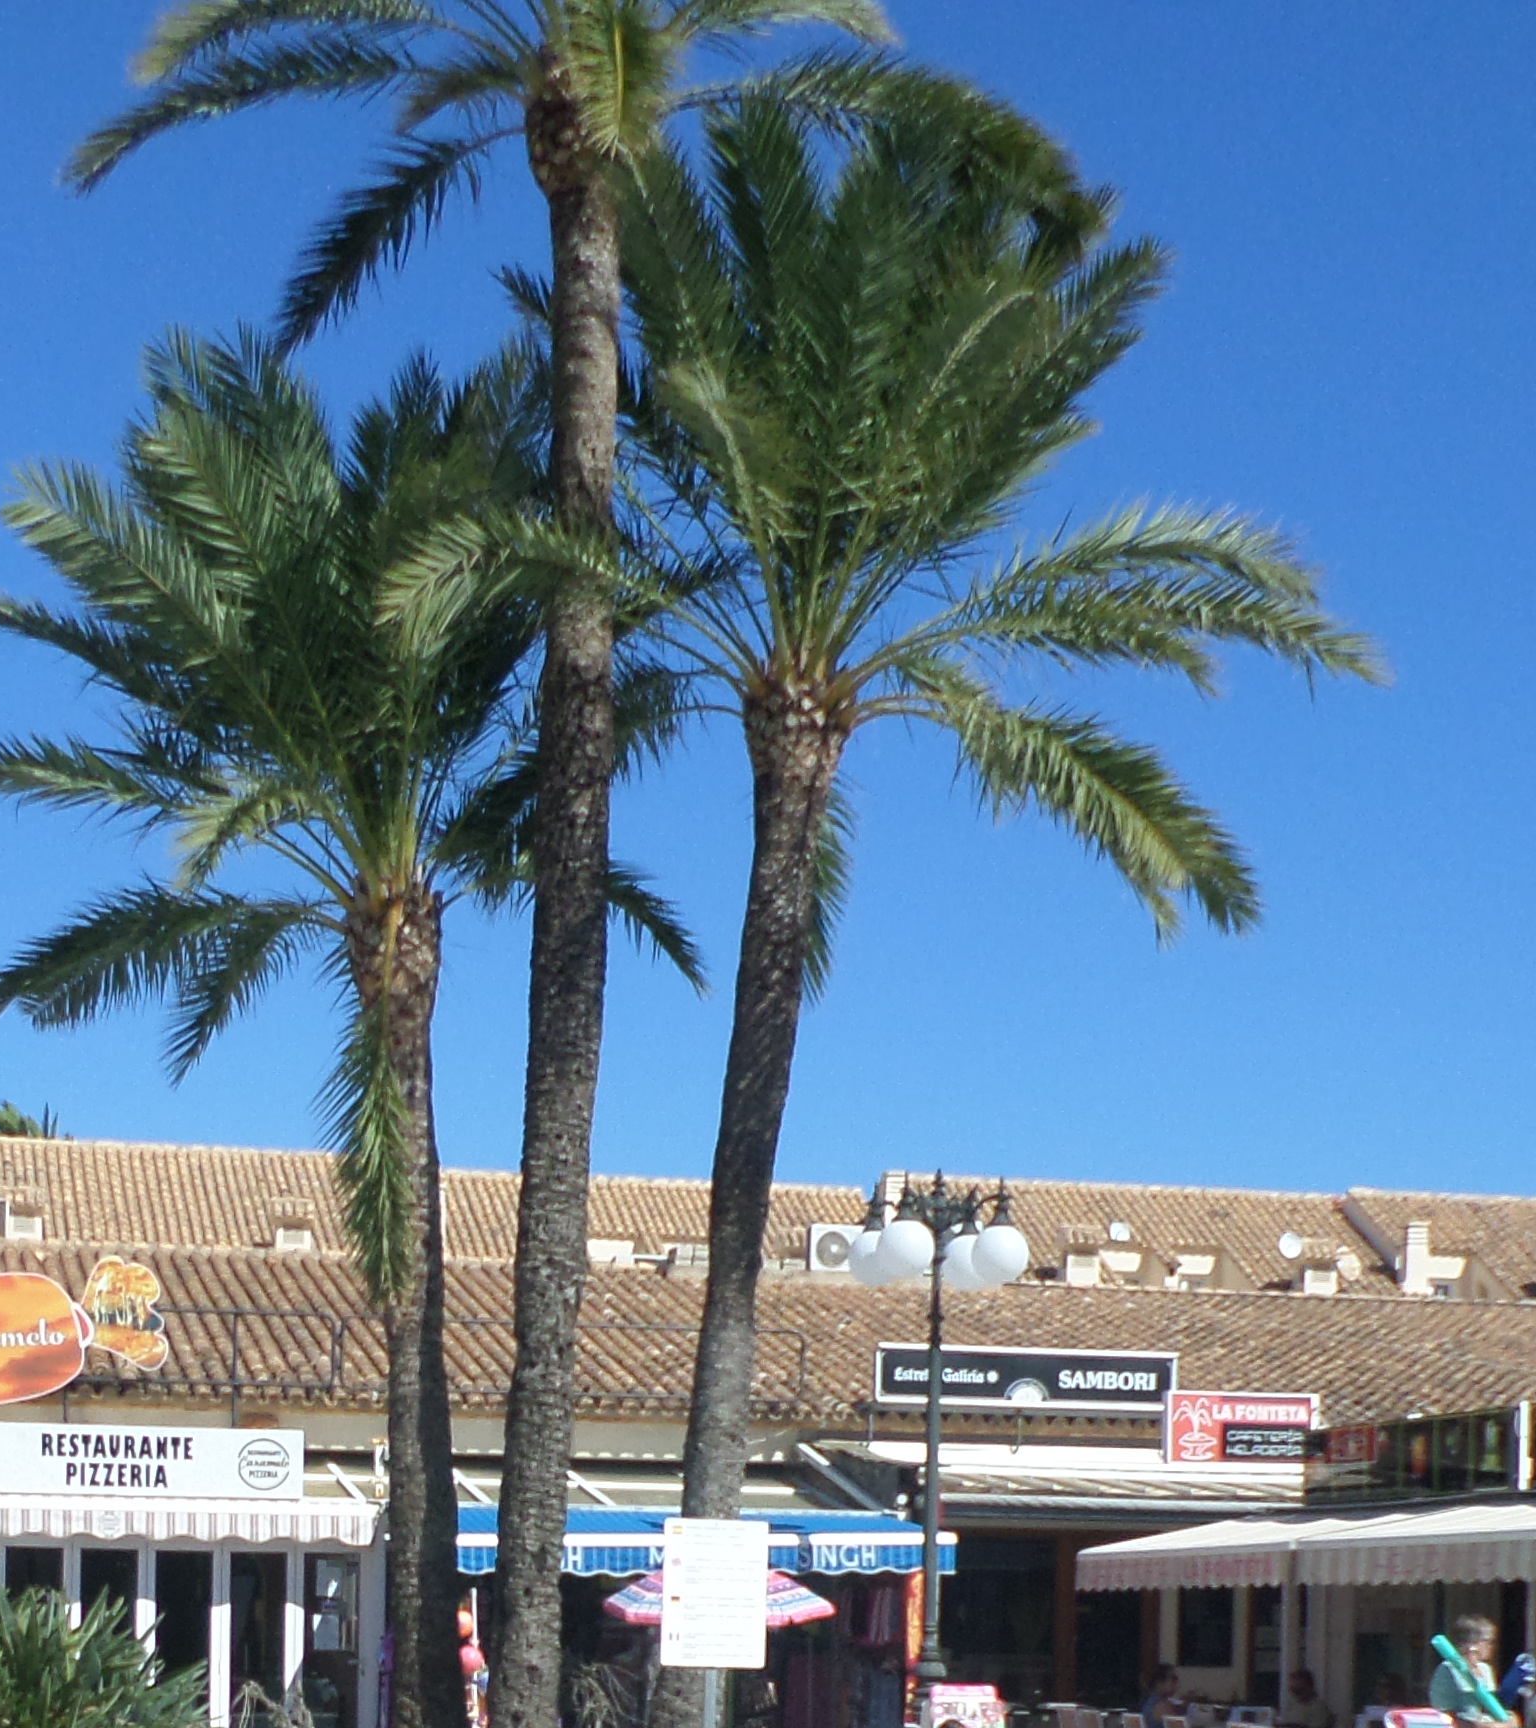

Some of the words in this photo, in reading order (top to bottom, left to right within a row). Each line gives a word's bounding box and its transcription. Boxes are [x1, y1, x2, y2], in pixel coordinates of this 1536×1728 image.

[1058, 1370, 1157, 1392] SAMBORI
[1213, 1405, 1232, 1420] LA
[1235, 1405, 1309, 1422] FONTETA
[41, 1432, 194, 1460] RESTAURANTE
[65, 1462, 169, 1489] PIZZERIA
